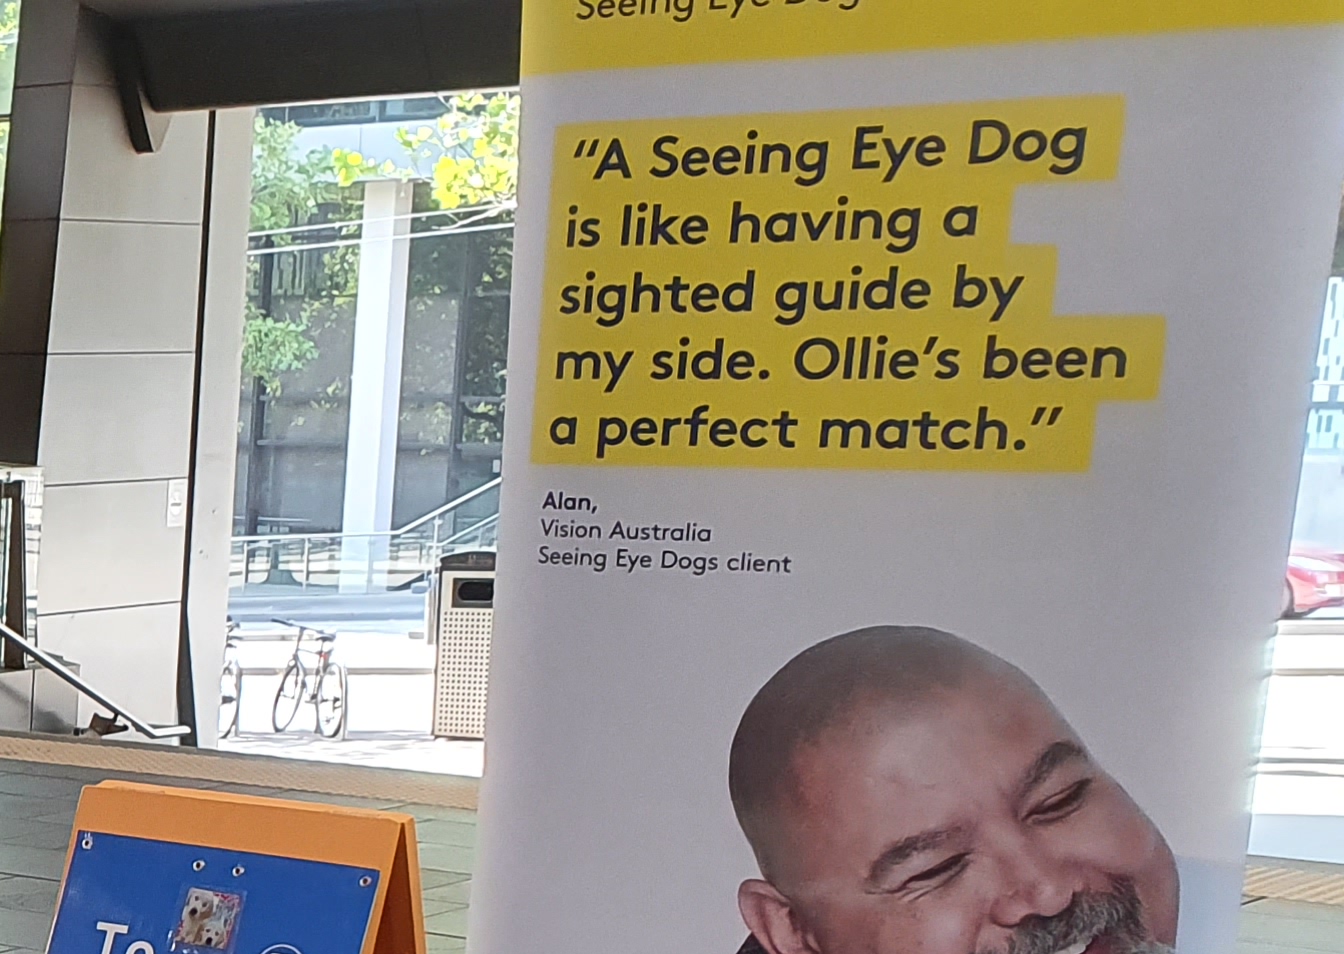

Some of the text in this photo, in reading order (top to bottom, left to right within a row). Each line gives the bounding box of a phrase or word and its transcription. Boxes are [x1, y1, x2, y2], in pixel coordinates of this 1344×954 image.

[648, 129, 829, 187] Seeing
[851, 125, 947, 182] Eye
[967, 119, 1088, 176] Dog
[566, 195, 979, 254] is like having a
[559, 263, 1025, 328] sighted guide by
[555, 334, 1127, 394] my side. Ollie's been
[549, 404, 1064, 459] a perfect match."
[540, 518, 712, 542] Vision Australia
[542, 491, 598, 515] Alan,
[538, 545, 792, 576] Seeing Eye Dogs client
